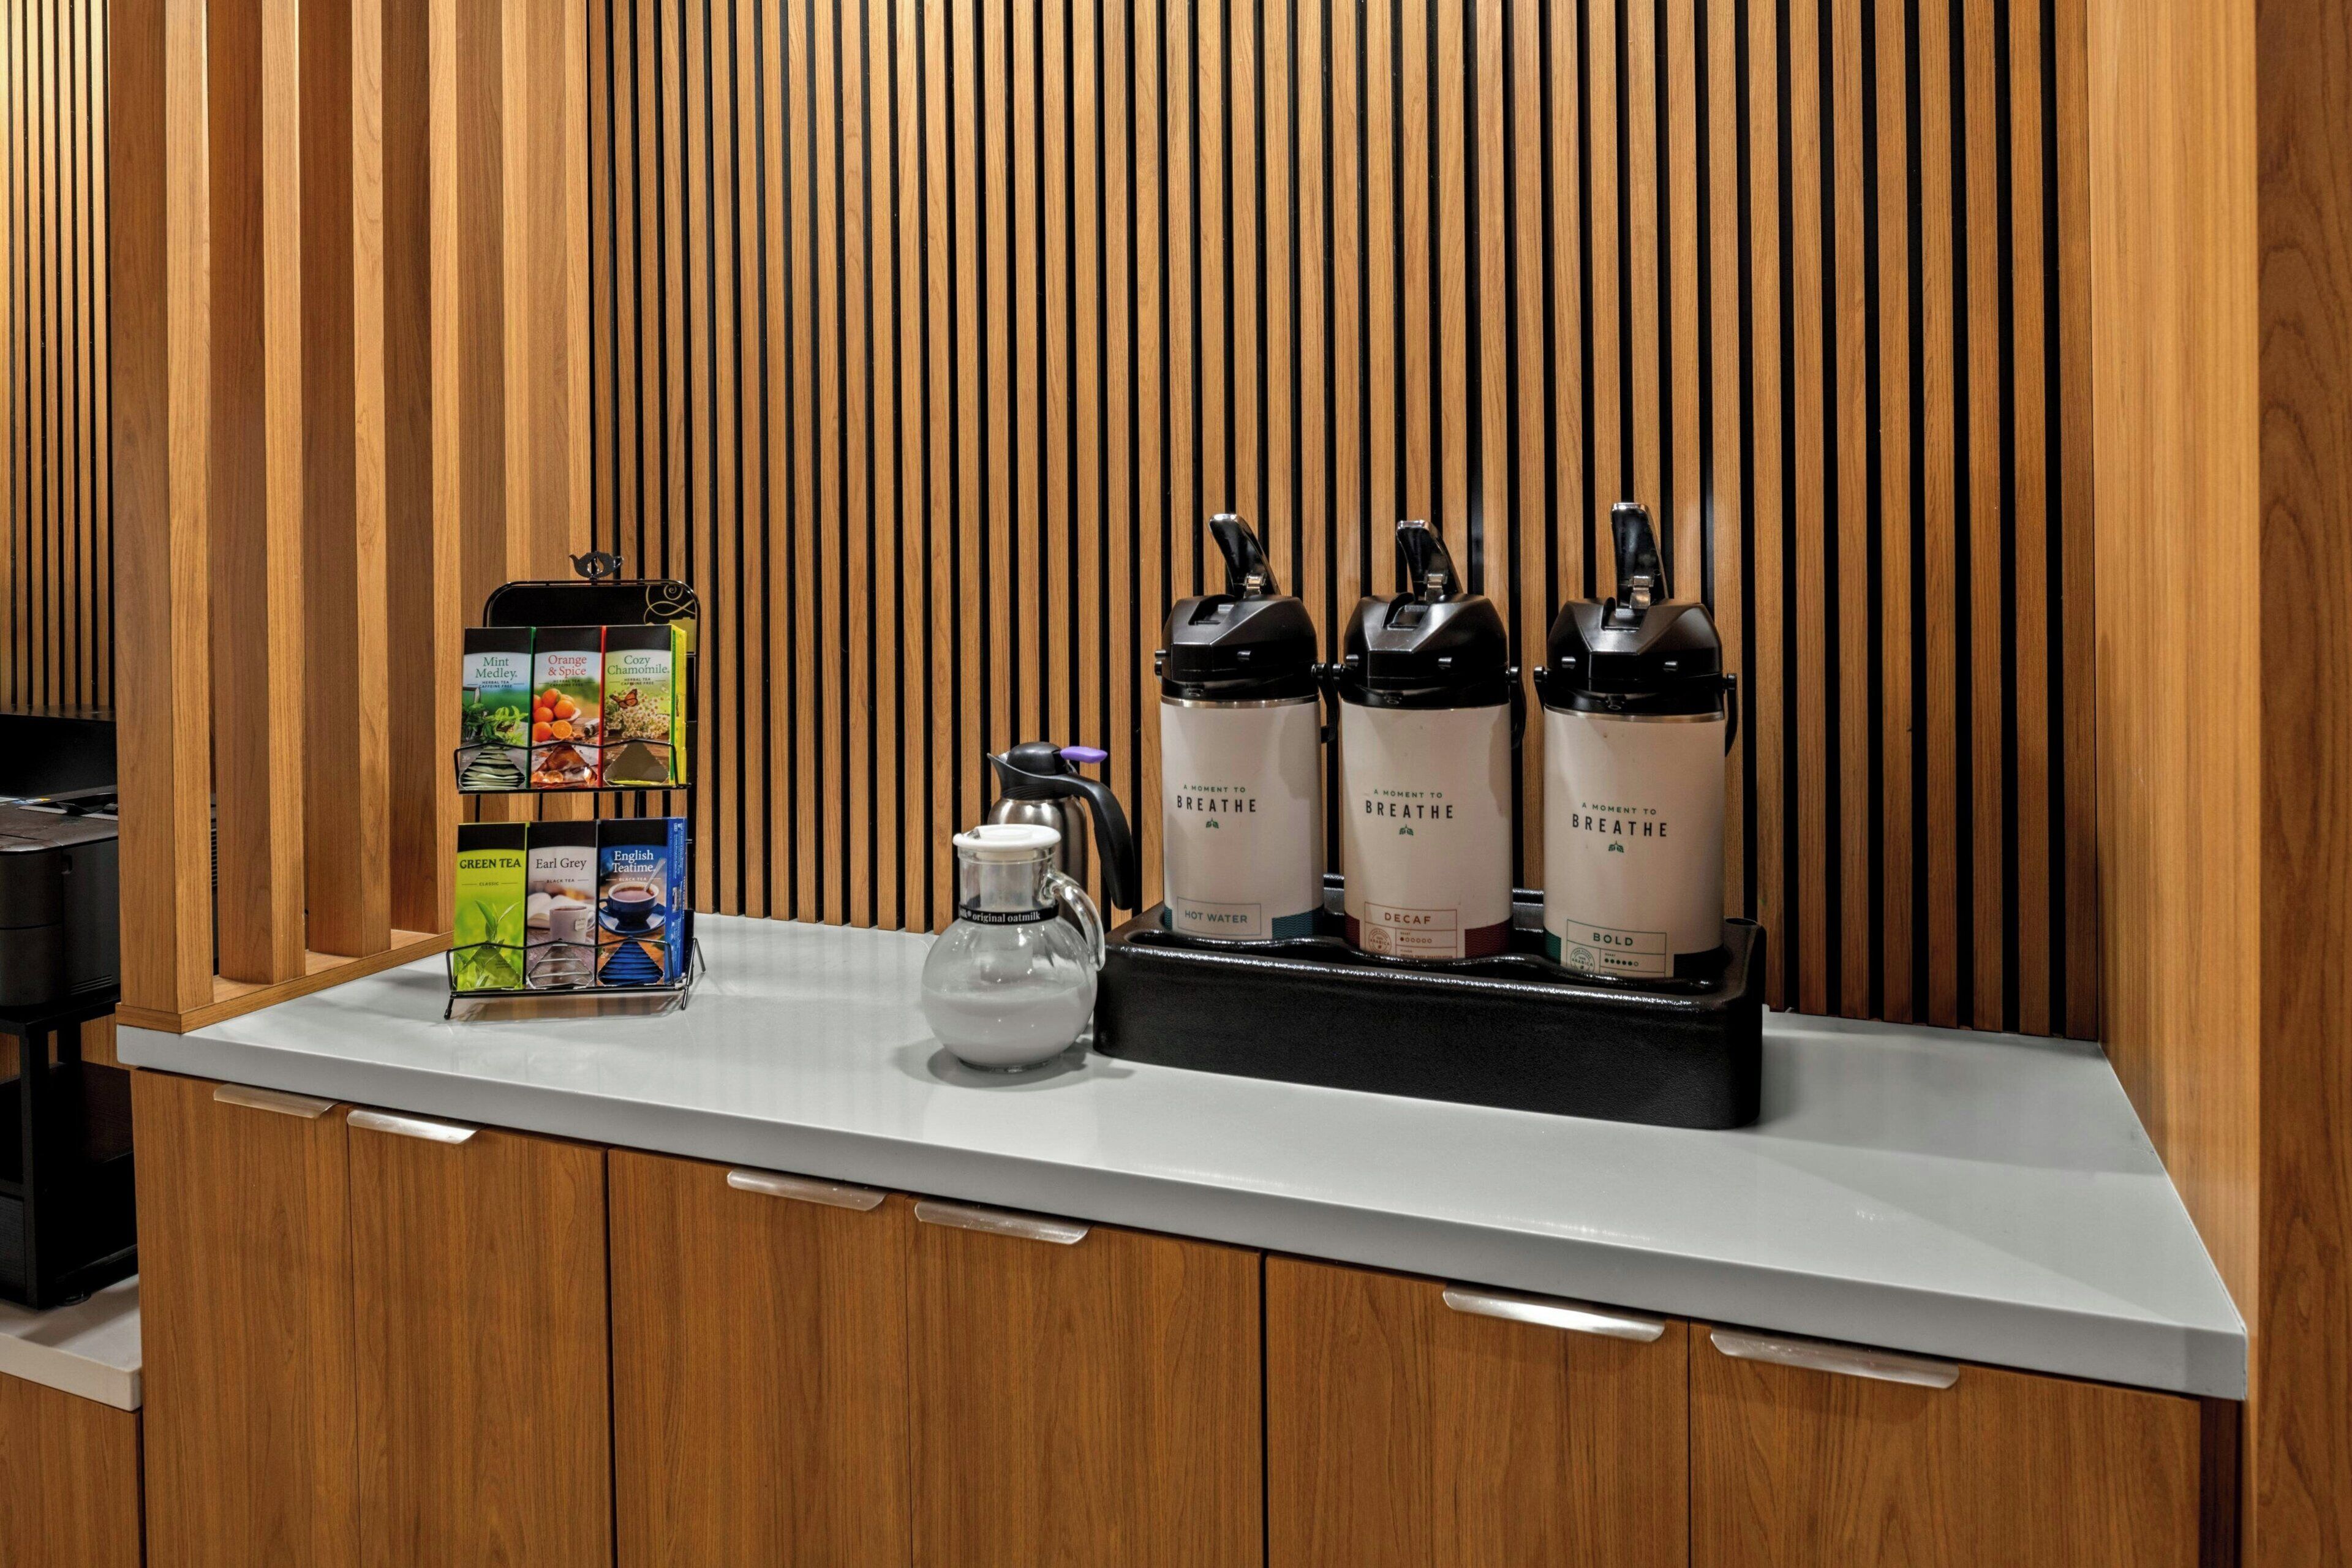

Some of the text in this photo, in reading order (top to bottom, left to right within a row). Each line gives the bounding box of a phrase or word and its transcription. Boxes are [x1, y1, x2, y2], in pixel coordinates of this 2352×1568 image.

[483, 657, 509, 666] Mint
[548, 655, 587, 667] Orange
[624, 655, 650, 666] Cozy
[548, 666, 586, 679] & Spice
[1177, 795, 1256, 812] BREATHE
[1366, 800, 1453, 819] BREATHE
[1593, 804, 1637, 813] MOMENT
[1572, 813, 1667, 837] BREATHE
[614, 850, 654, 864] English
[460, 858, 521, 869] GREEN TEA
[536, 858, 587, 870] Earl Grey
[973, 913, 1005, 923] original
[1008, 911, 1041, 922] oatmilk
[1185, 910, 1248, 923] HOT WATER
[1385, 912, 1431, 924] DECAF
[1593, 933, 1633, 946] BOLD
[1572, 957, 1593, 967] ARABICA
